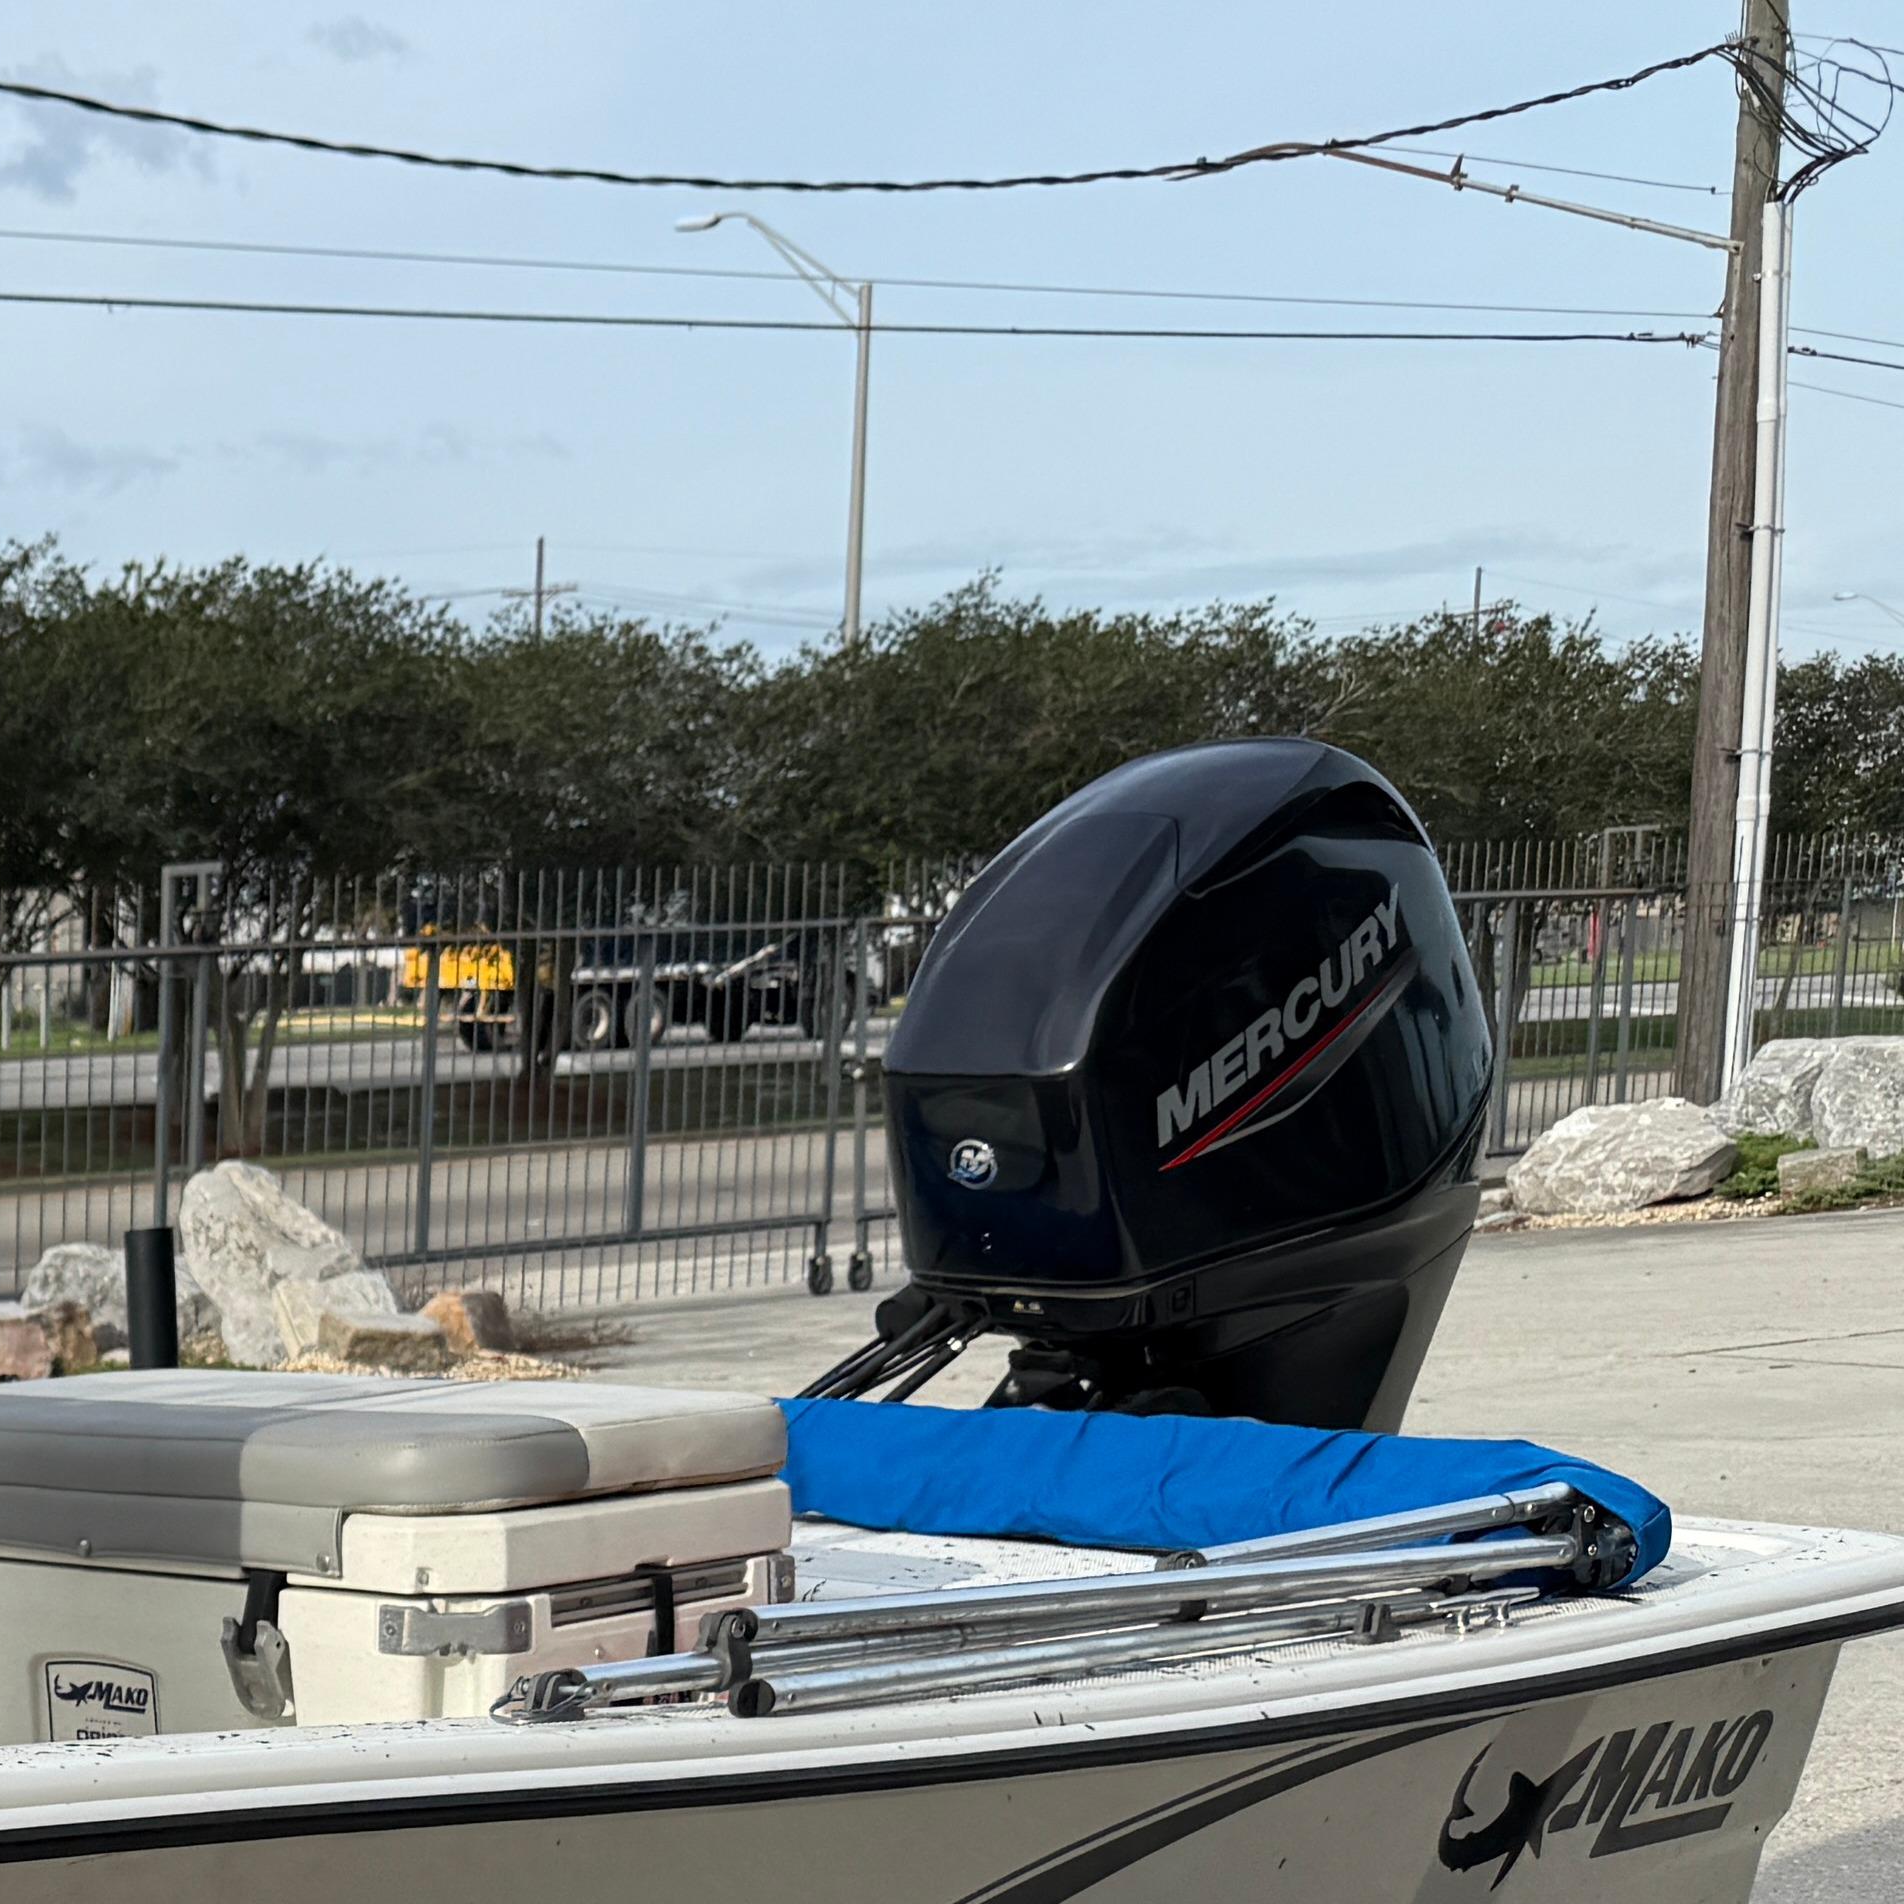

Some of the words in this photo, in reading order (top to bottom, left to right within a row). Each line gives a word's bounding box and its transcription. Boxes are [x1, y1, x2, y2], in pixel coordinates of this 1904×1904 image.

[1157, 882, 1400, 1148] MERCURY
[87, 1681, 149, 1714] MAKO
[1548, 1709, 1774, 1858] MAKO
